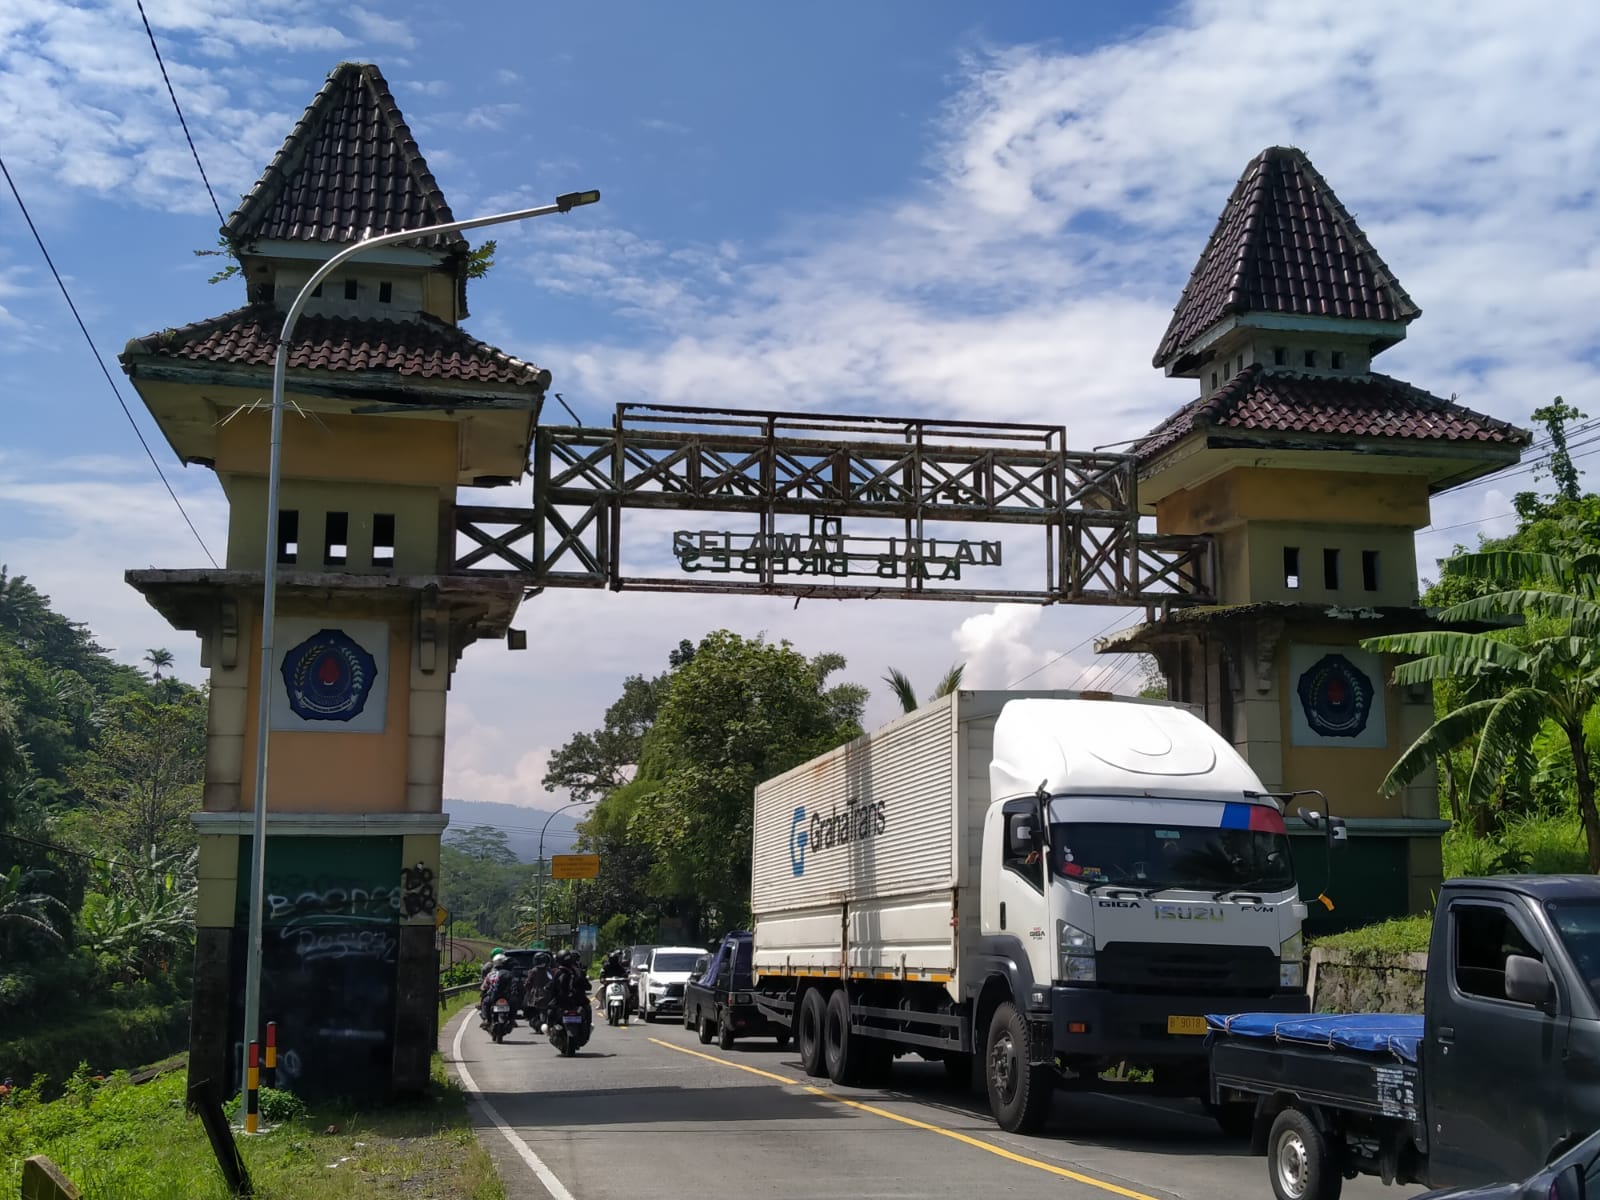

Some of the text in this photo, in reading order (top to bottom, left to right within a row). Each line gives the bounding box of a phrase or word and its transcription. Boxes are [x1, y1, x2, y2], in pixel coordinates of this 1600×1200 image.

[673, 530, 1001, 566] SELAMAT JALAN
[1154, 905, 1224, 921] ISUZU
[1240, 905, 1274, 913] FVM
